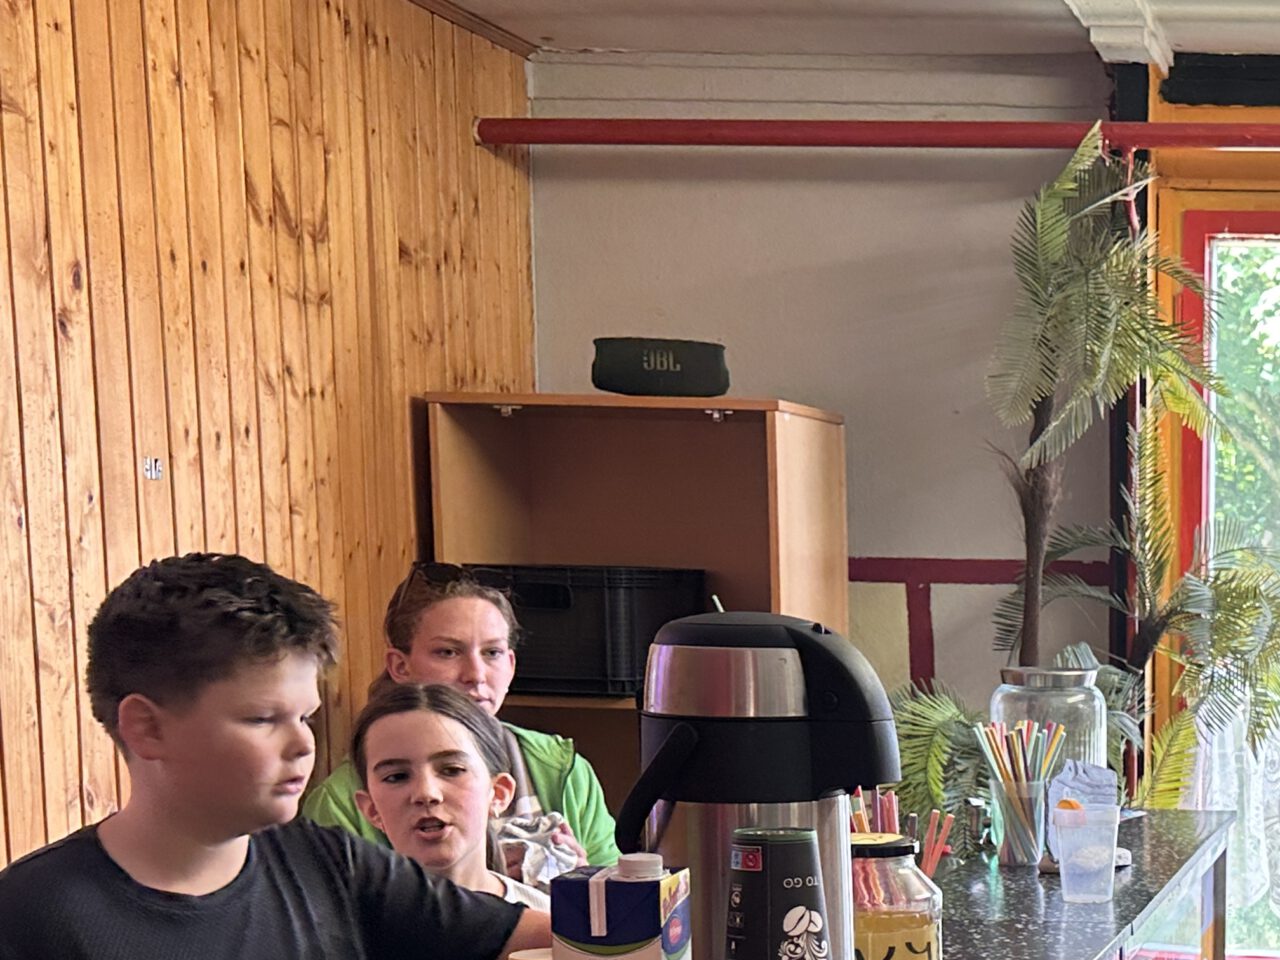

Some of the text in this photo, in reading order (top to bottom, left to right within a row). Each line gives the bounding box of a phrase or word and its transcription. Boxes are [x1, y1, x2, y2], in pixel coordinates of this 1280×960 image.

[643, 350, 680, 371] JBL
[783, 876, 819, 888] TO GO
